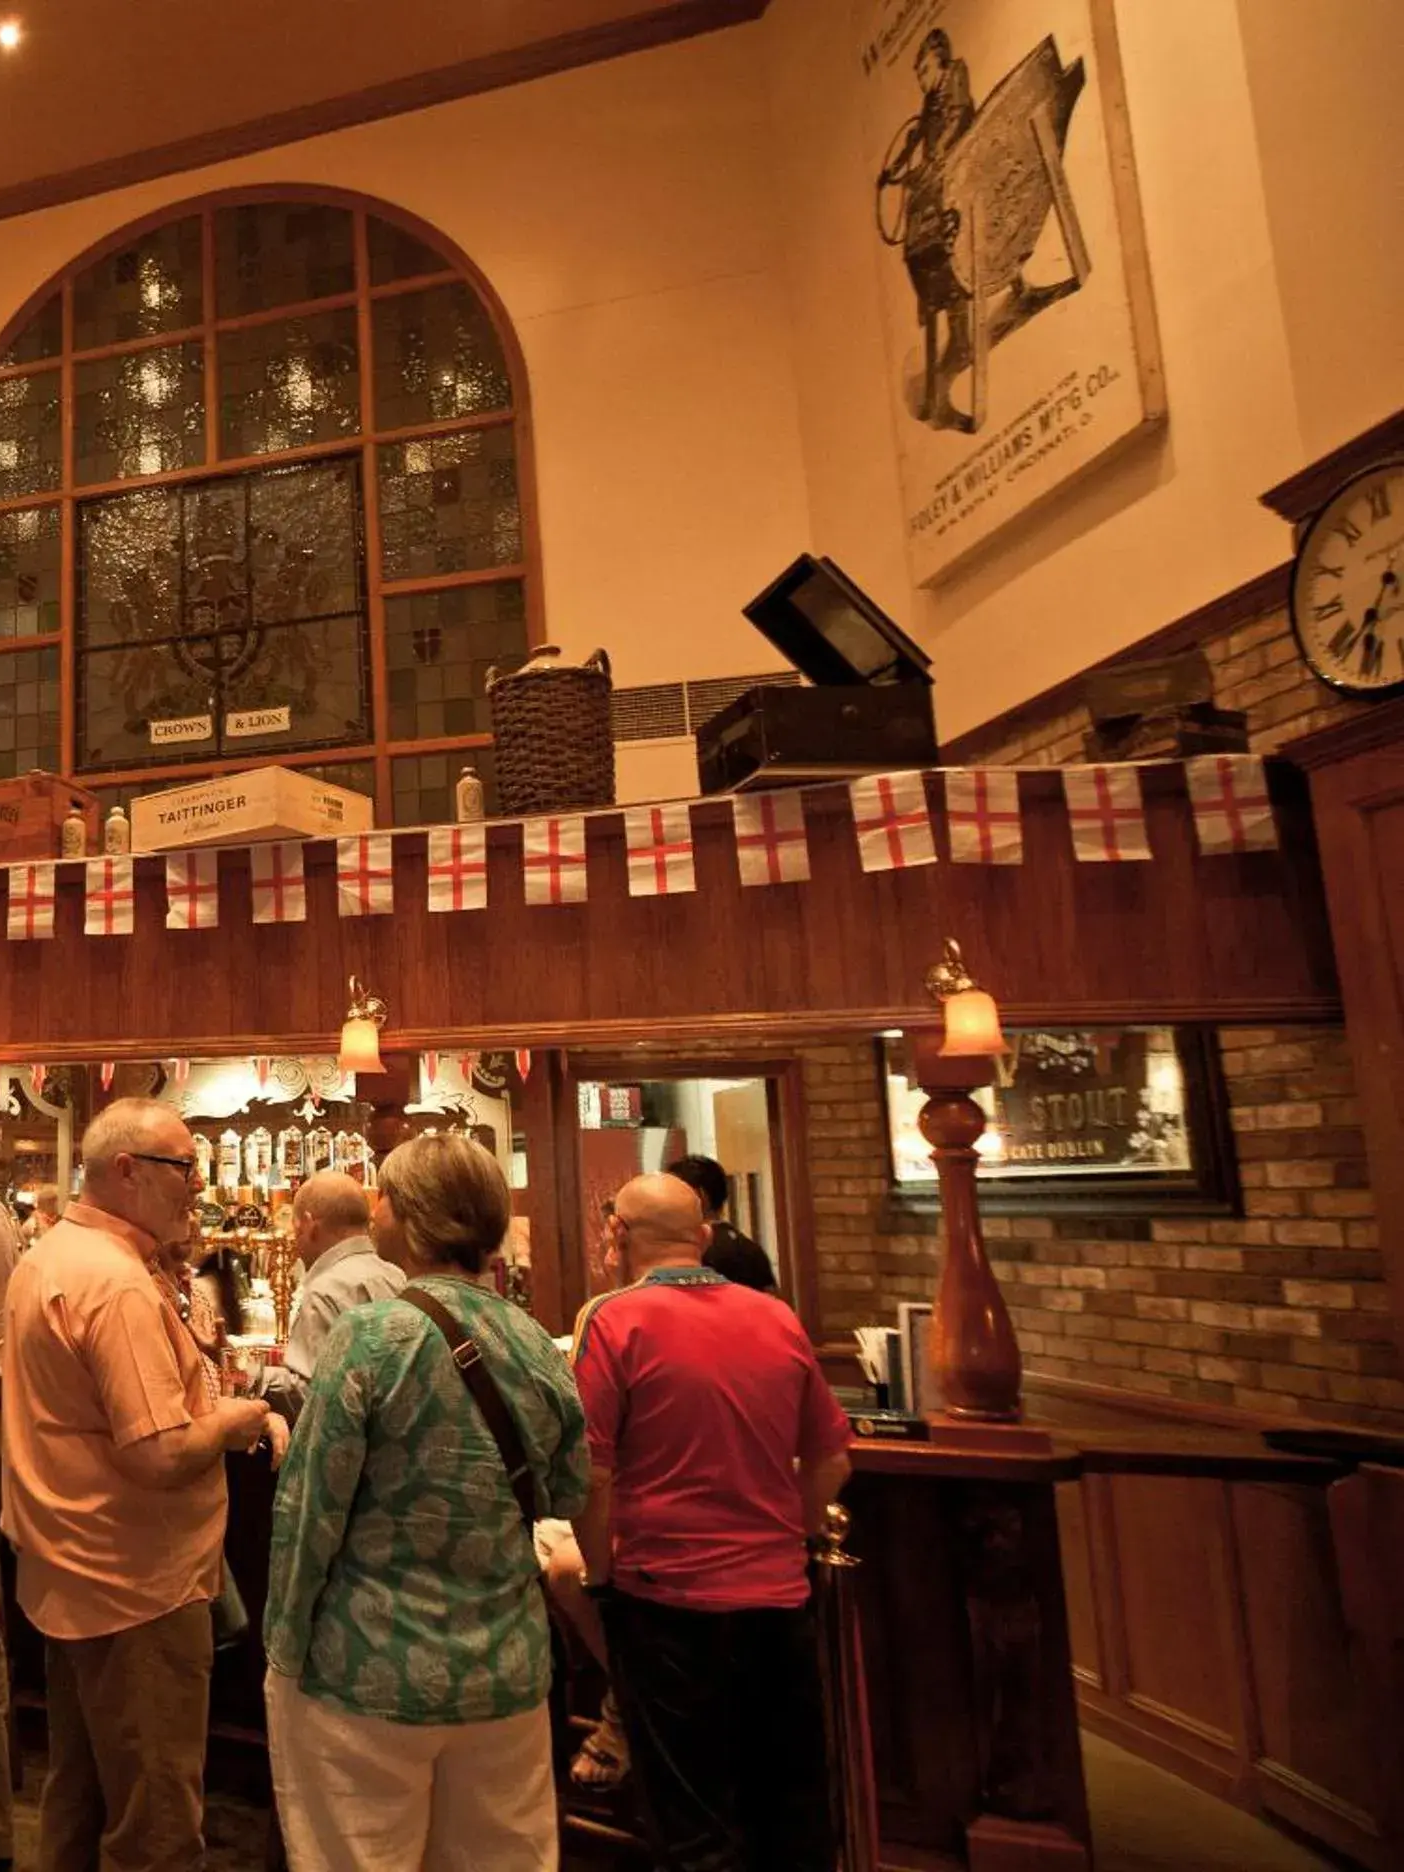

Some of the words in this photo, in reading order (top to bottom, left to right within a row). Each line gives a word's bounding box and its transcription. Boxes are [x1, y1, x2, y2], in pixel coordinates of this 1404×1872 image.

[154, 720, 208, 738] CROWN
[235, 718, 245, 730] &
[248, 712, 283, 728] LION
[157, 794, 247, 825] TAITTINGER
[1029, 1086, 1128, 1132] STOUT
